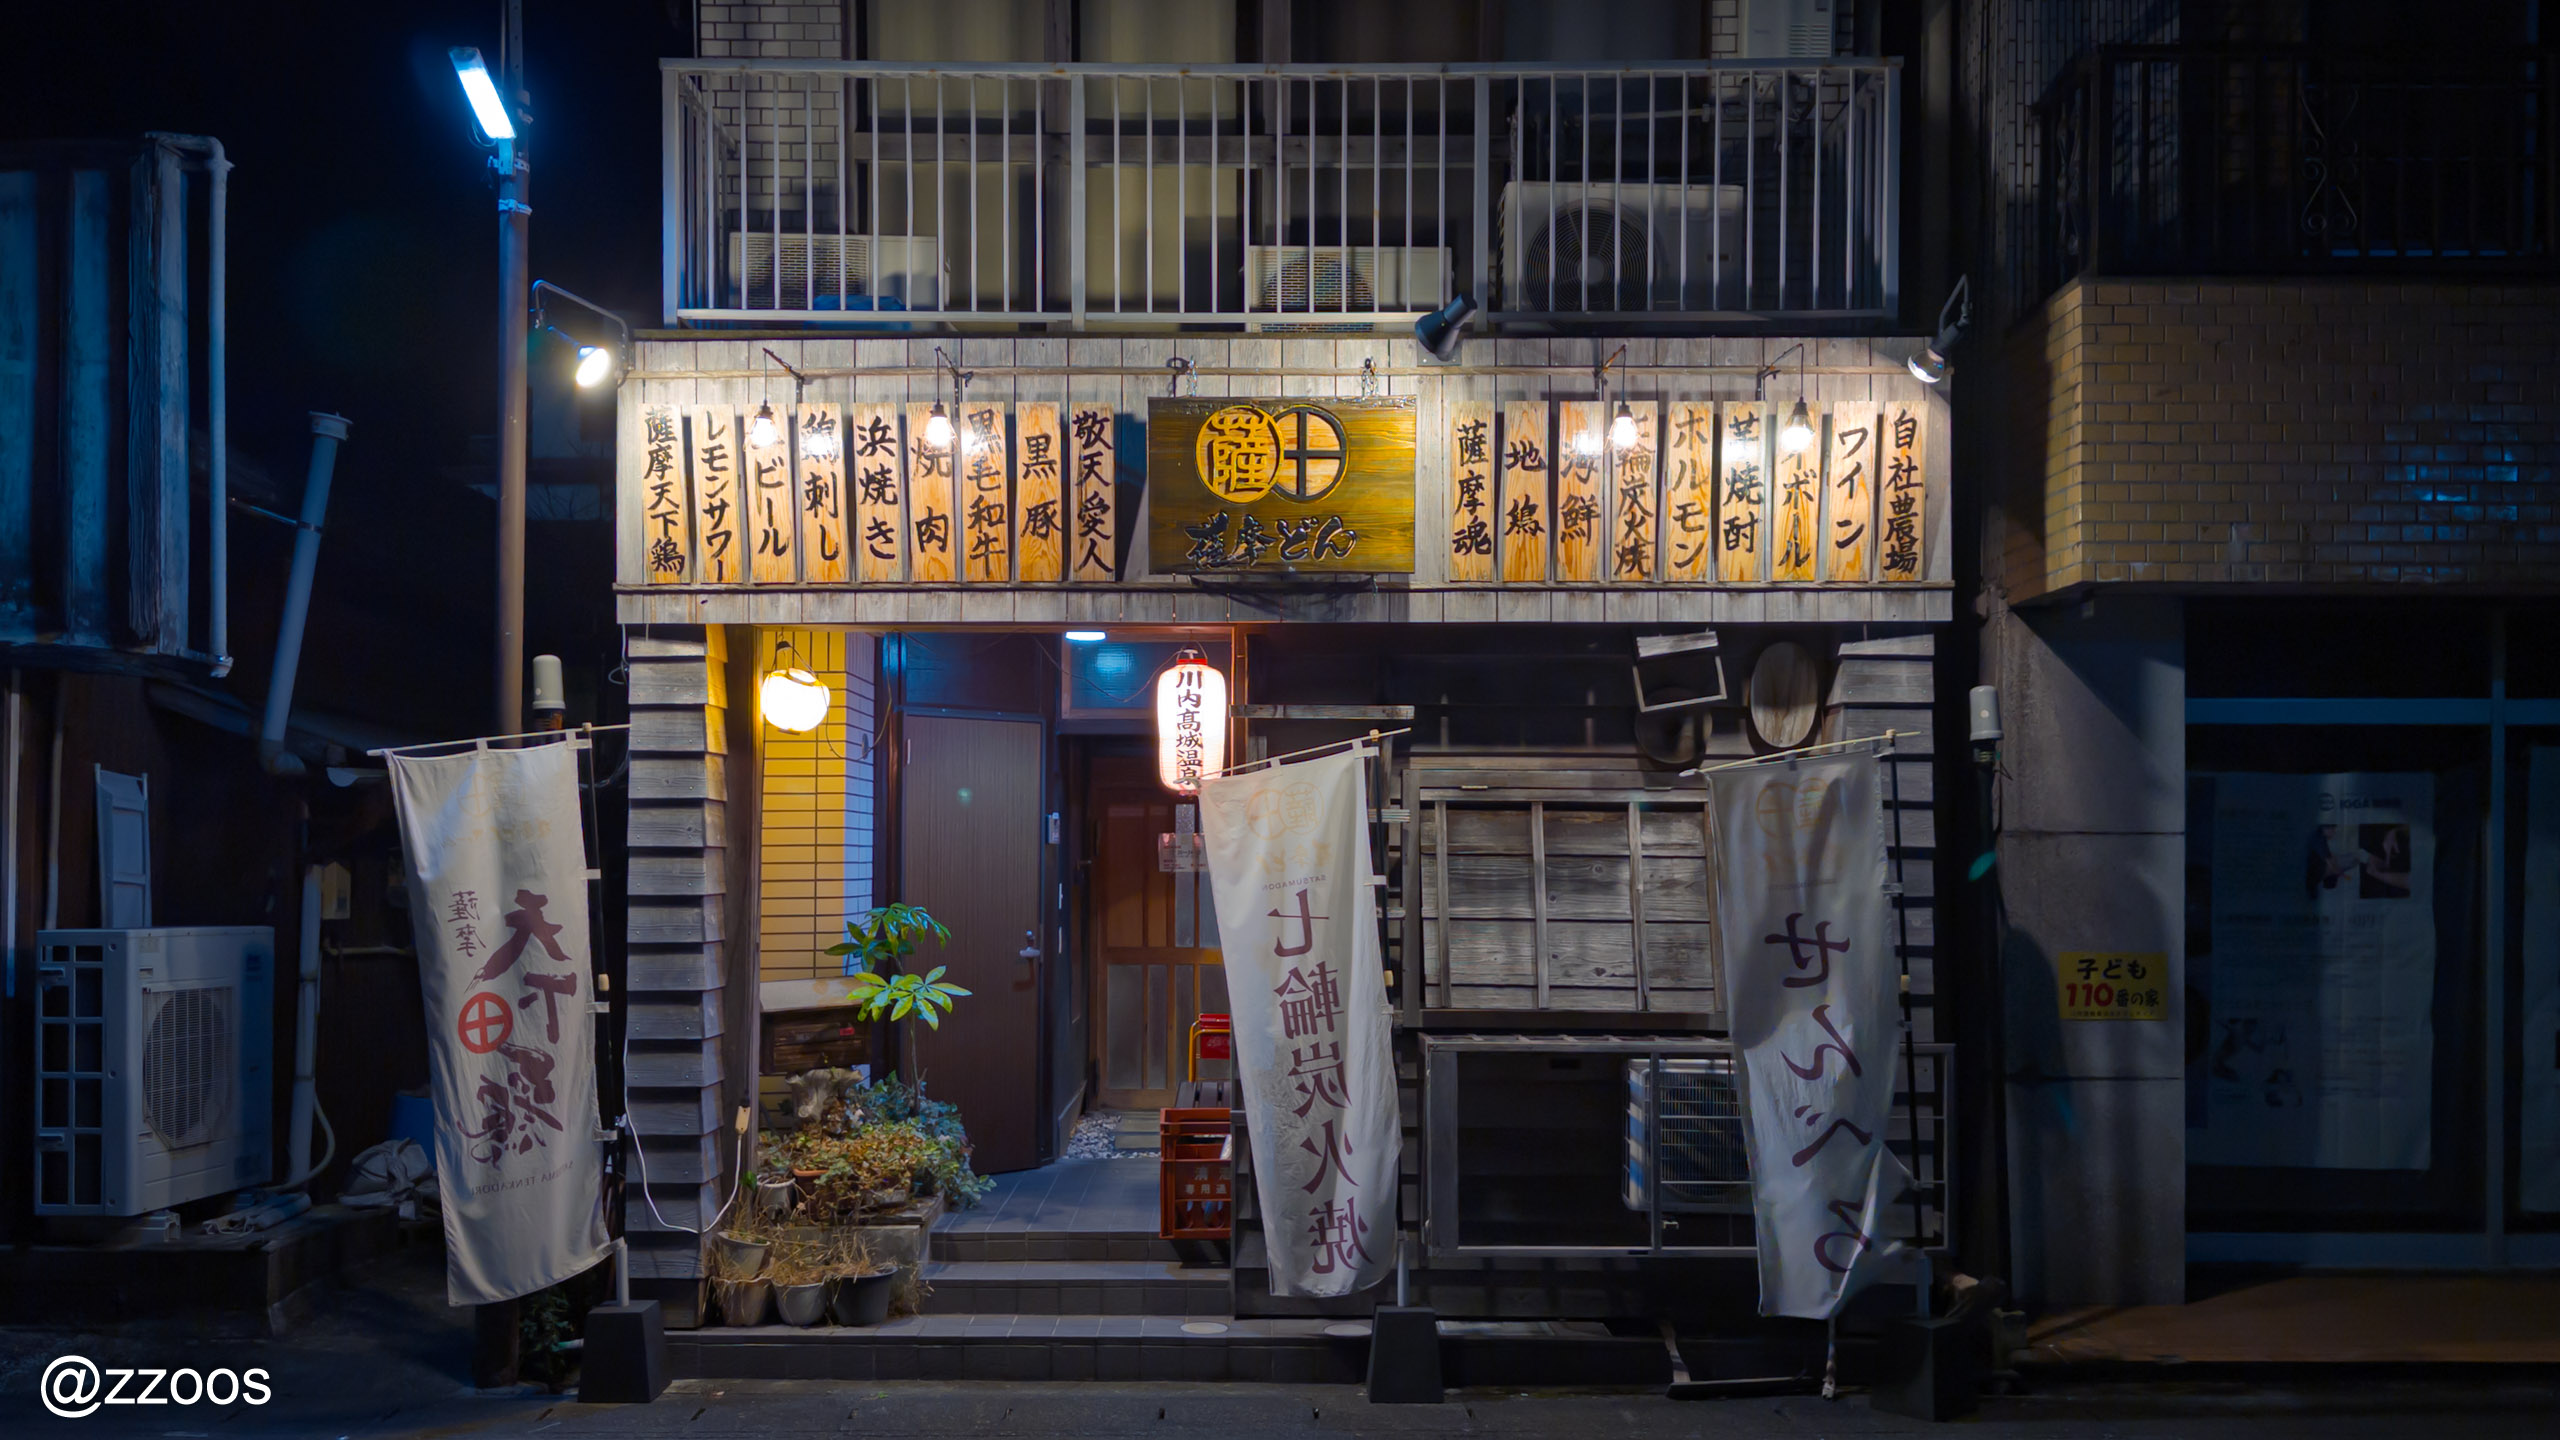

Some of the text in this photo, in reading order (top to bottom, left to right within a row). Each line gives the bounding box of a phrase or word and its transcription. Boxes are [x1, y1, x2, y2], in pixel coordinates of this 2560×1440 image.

[701, 410, 733, 582] レモンサワー
[752, 430, 791, 557] ビール
[856, 415, 899, 560] 浜焼き
[910, 432, 952, 554] 焼肉
[966, 408, 1007, 579] 黒毛和牛
[1020, 433, 1062, 541] 黒豚
[1072, 410, 1115, 574] 敬天愛人
[1452, 418, 1493, 557] 薩摩魂
[1504, 439, 1548, 538] 地鶏
[1612, 414, 1656, 577] 輪炭火焼
[1672, 408, 1710, 569] ホルモン
[1835, 426, 1870, 550] ワイン
[1882, 407, 1925, 575] 自社農場
[2076, 957, 2148, 980] 子ども
